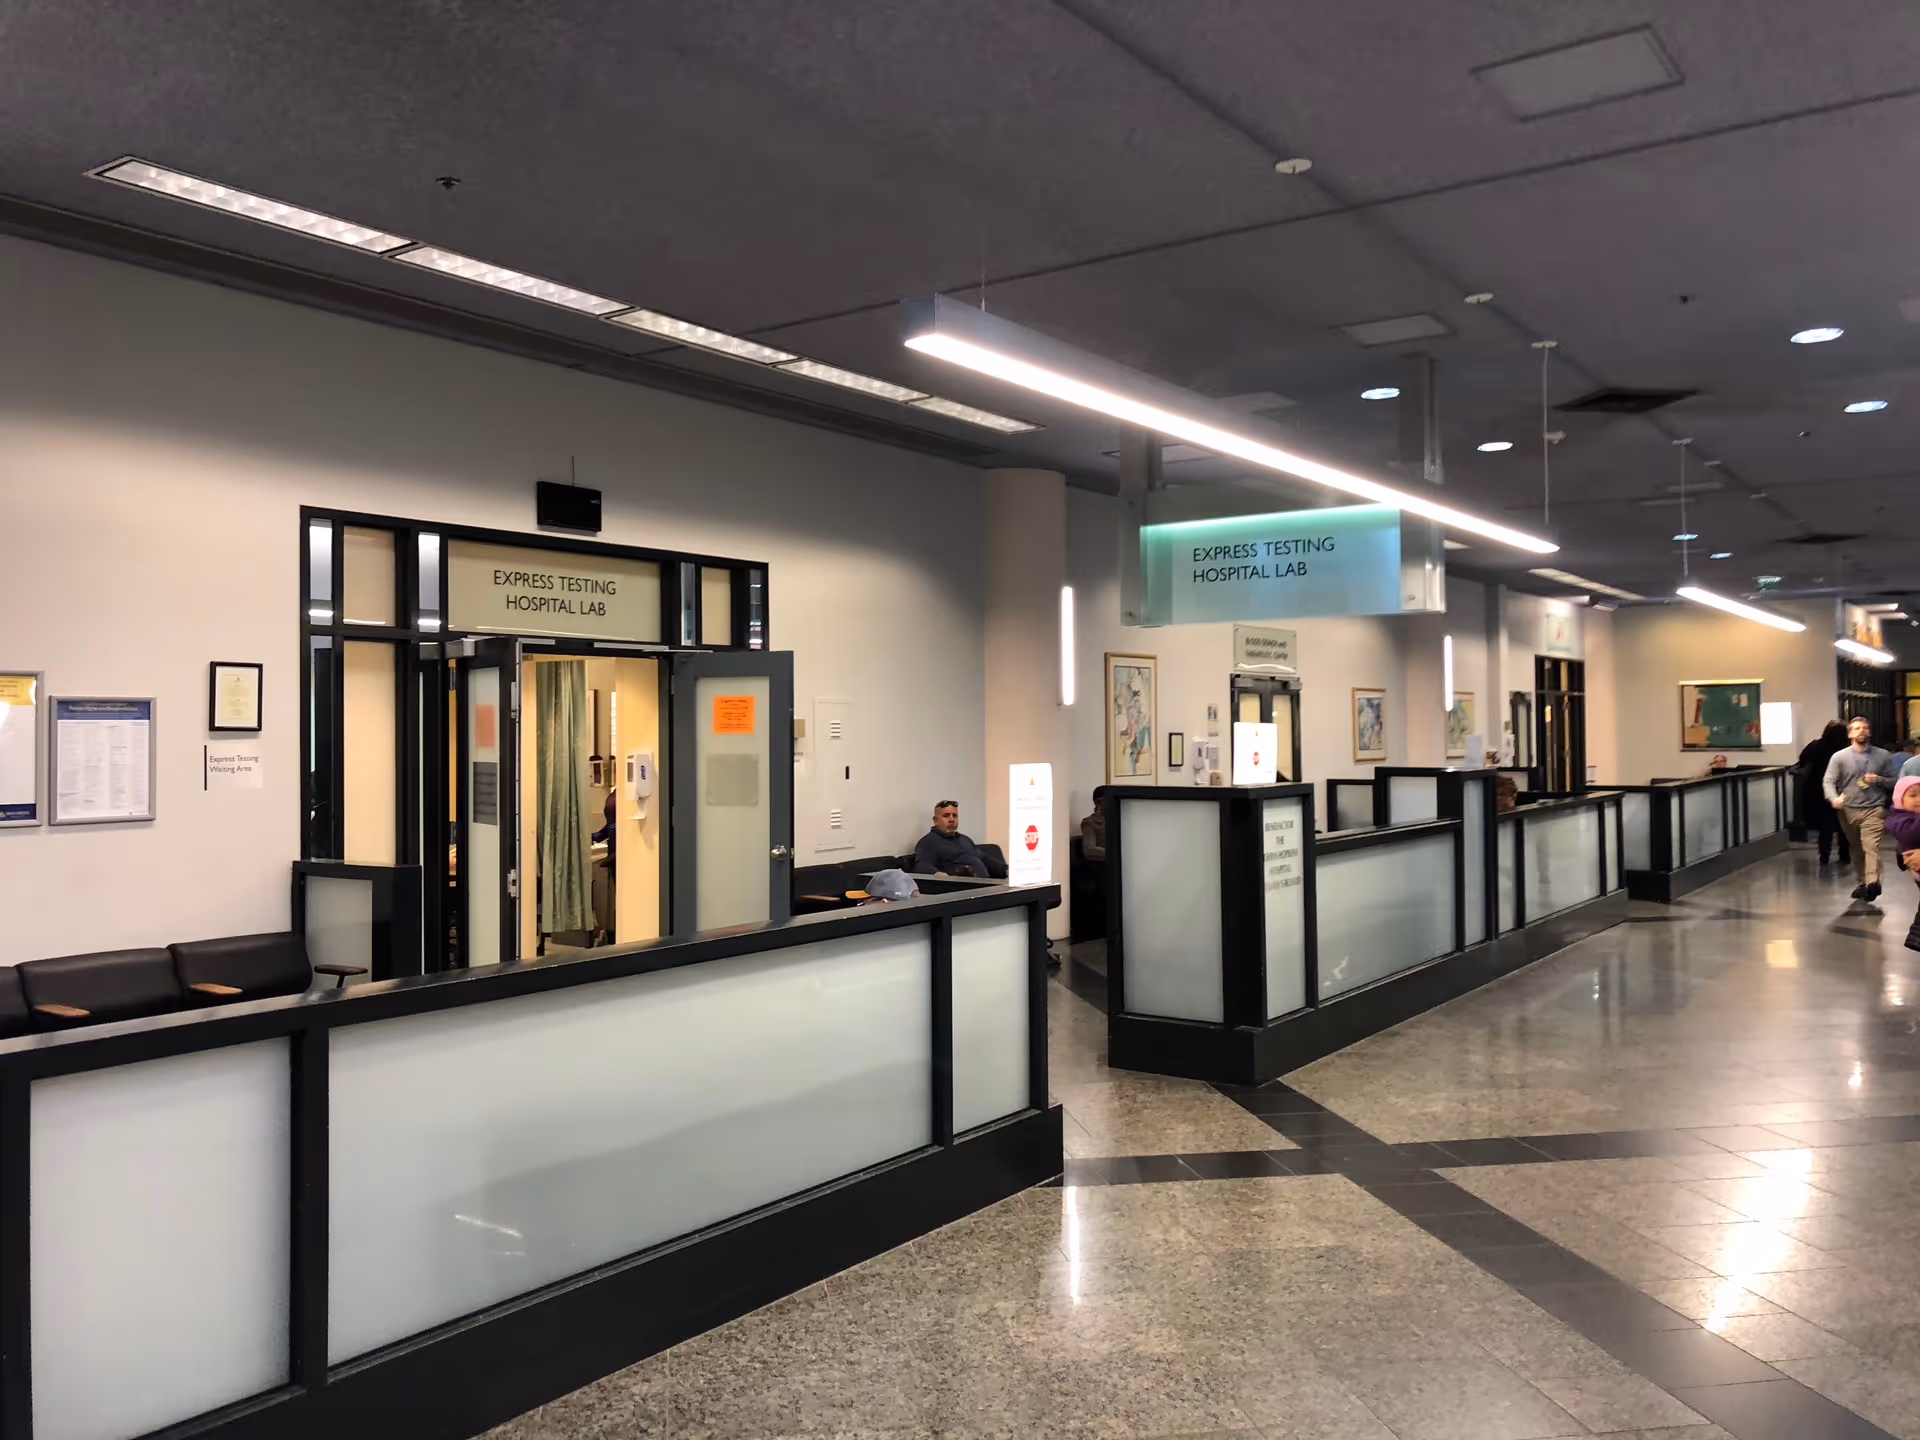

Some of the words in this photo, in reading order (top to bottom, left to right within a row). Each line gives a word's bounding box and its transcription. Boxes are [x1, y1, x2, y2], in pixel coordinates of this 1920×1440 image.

[1193, 543, 1258, 562] EXPRESS
[1263, 536, 1335, 556] TESTING
[494, 569, 554, 590] EXPRESS
[558, 576, 617, 595] TESTING
[1193, 565, 1270, 583] HOSPITAL
[1275, 561, 1308, 578] LAB
[506, 594, 576, 614] HOSPITAL
[580, 600, 606, 616] LAB
[209, 755, 235, 764] Express
[236, 754, 259, 763] Testing
[209, 766, 236, 774] Waiting
[1025, 831, 1039, 844] STOP
